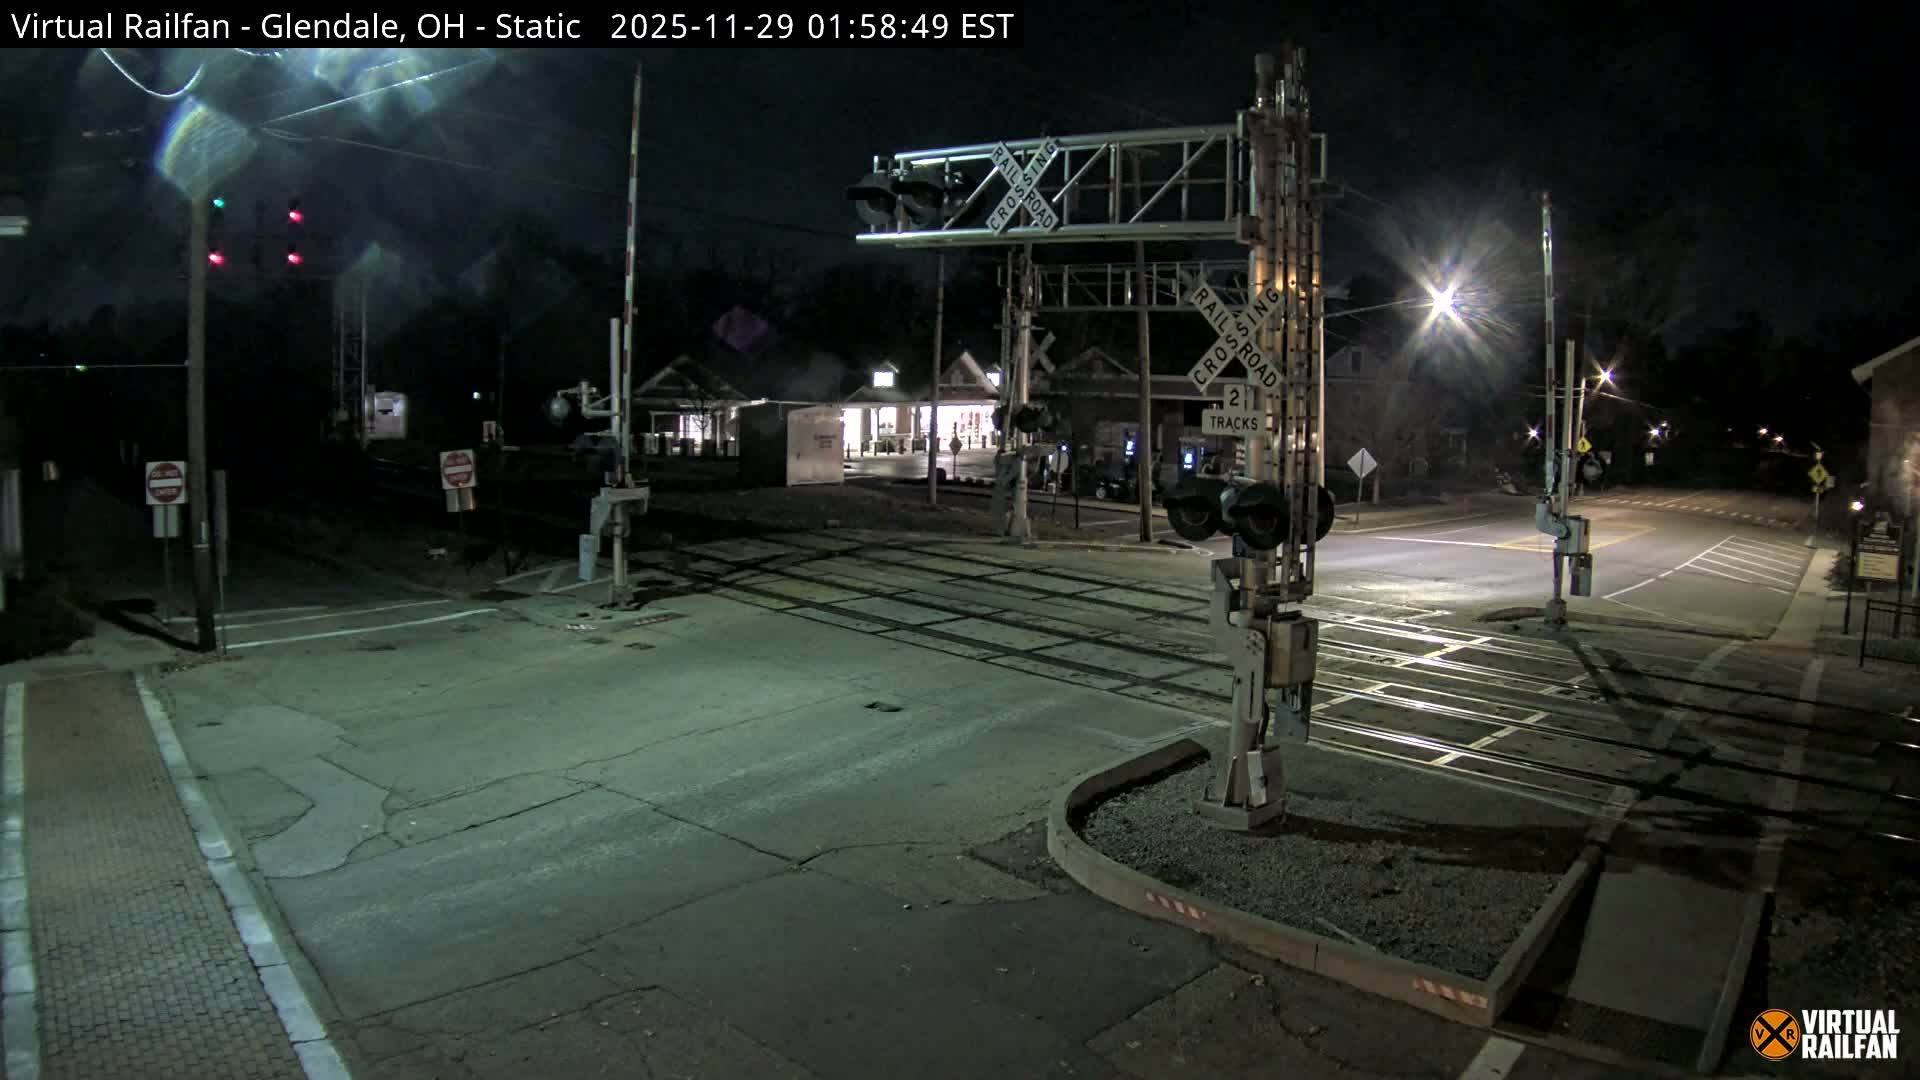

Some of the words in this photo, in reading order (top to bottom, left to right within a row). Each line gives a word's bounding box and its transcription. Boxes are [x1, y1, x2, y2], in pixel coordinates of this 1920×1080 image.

[990, 142, 1057, 230] CROSSING
[1194, 287, 1279, 385] CROSSING
[1210, 415, 1258, 431] TRACKS
[1229, 387, 1240, 407] 2
